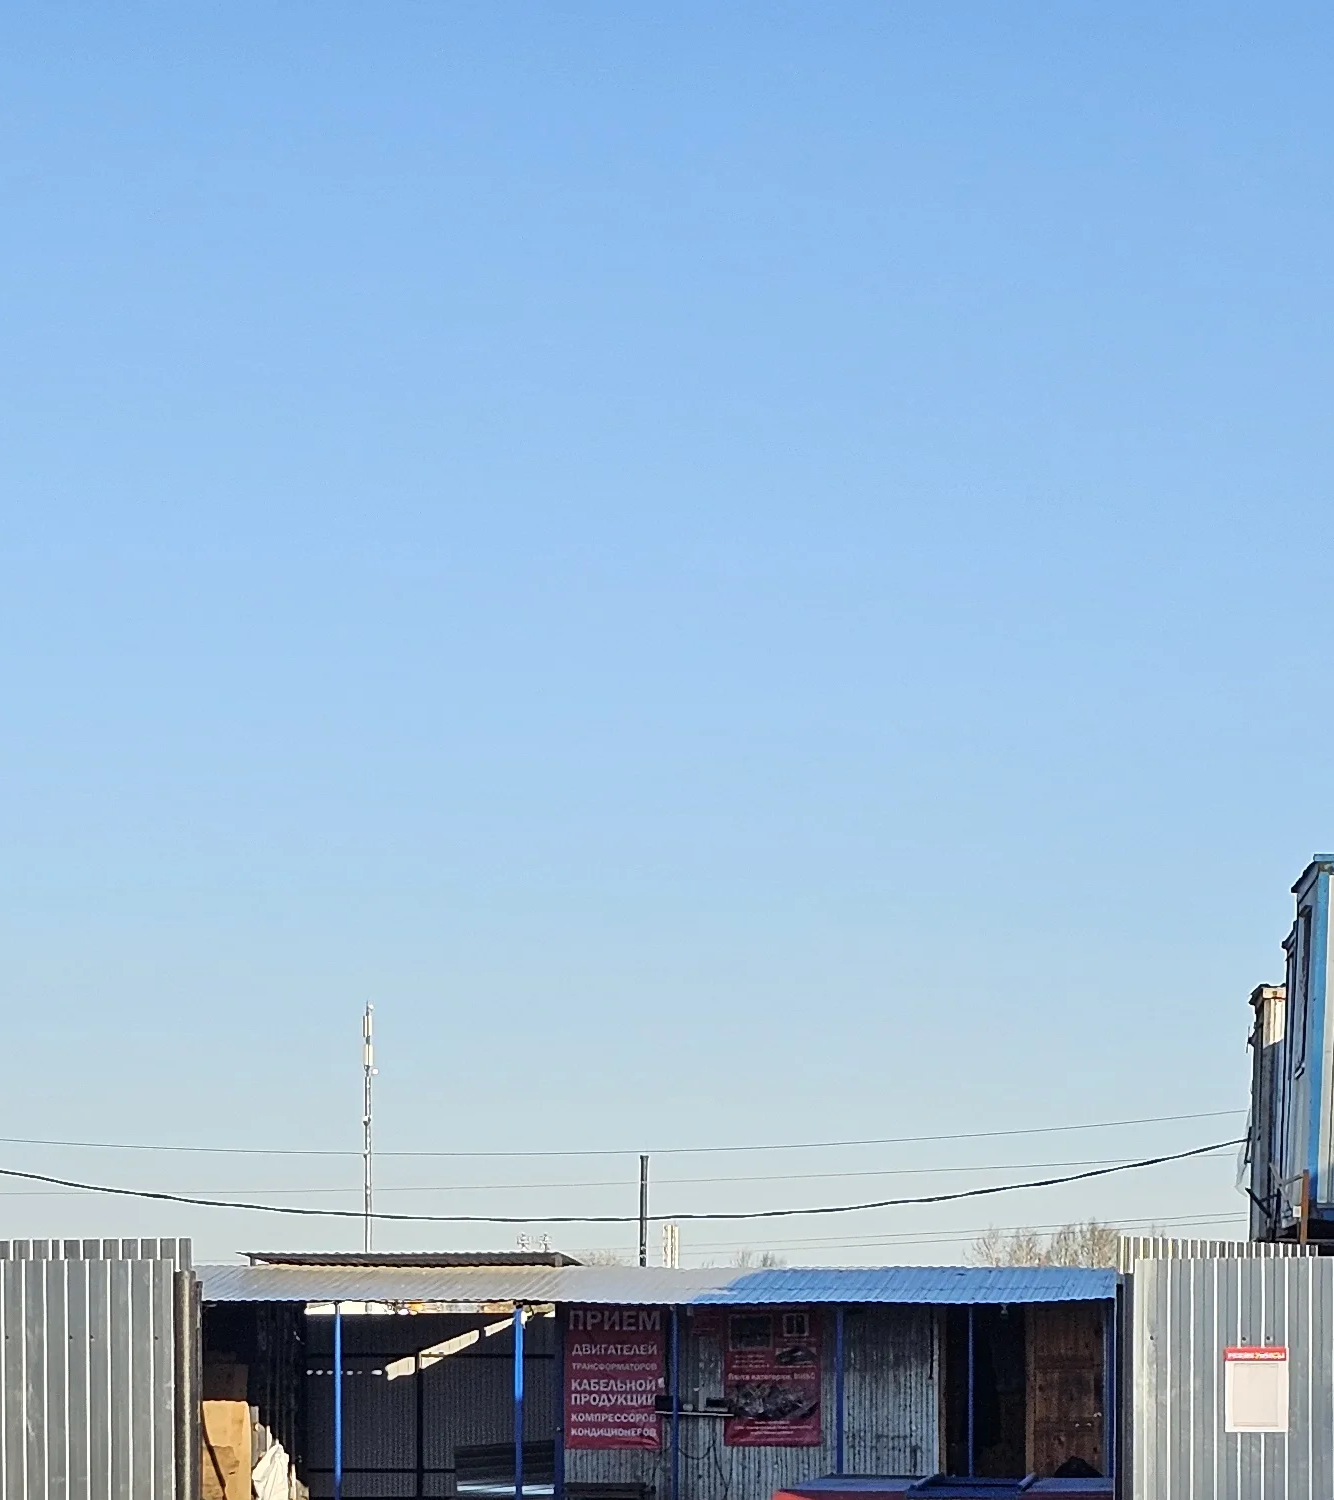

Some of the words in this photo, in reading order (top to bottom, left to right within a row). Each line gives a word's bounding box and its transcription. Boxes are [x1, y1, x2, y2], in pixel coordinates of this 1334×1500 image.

[569, 1310, 660, 1331] ПРИЕМ
[572, 1342, 657, 1356] ДВИГАТЕЛЕЙ
[572, 1362, 657, 1371] ТРАНСФОРМАТОРОВ
[571, 1377, 656, 1391] КАБЕЛЬНОЙ
[571, 1393, 656, 1407] ПРОДУКЦИИ
[571, 1413, 657, 1423] КОМПРЕССОРОВ
[571, 1427, 657, 1438] КОНДИЦИОНЕРОВ
